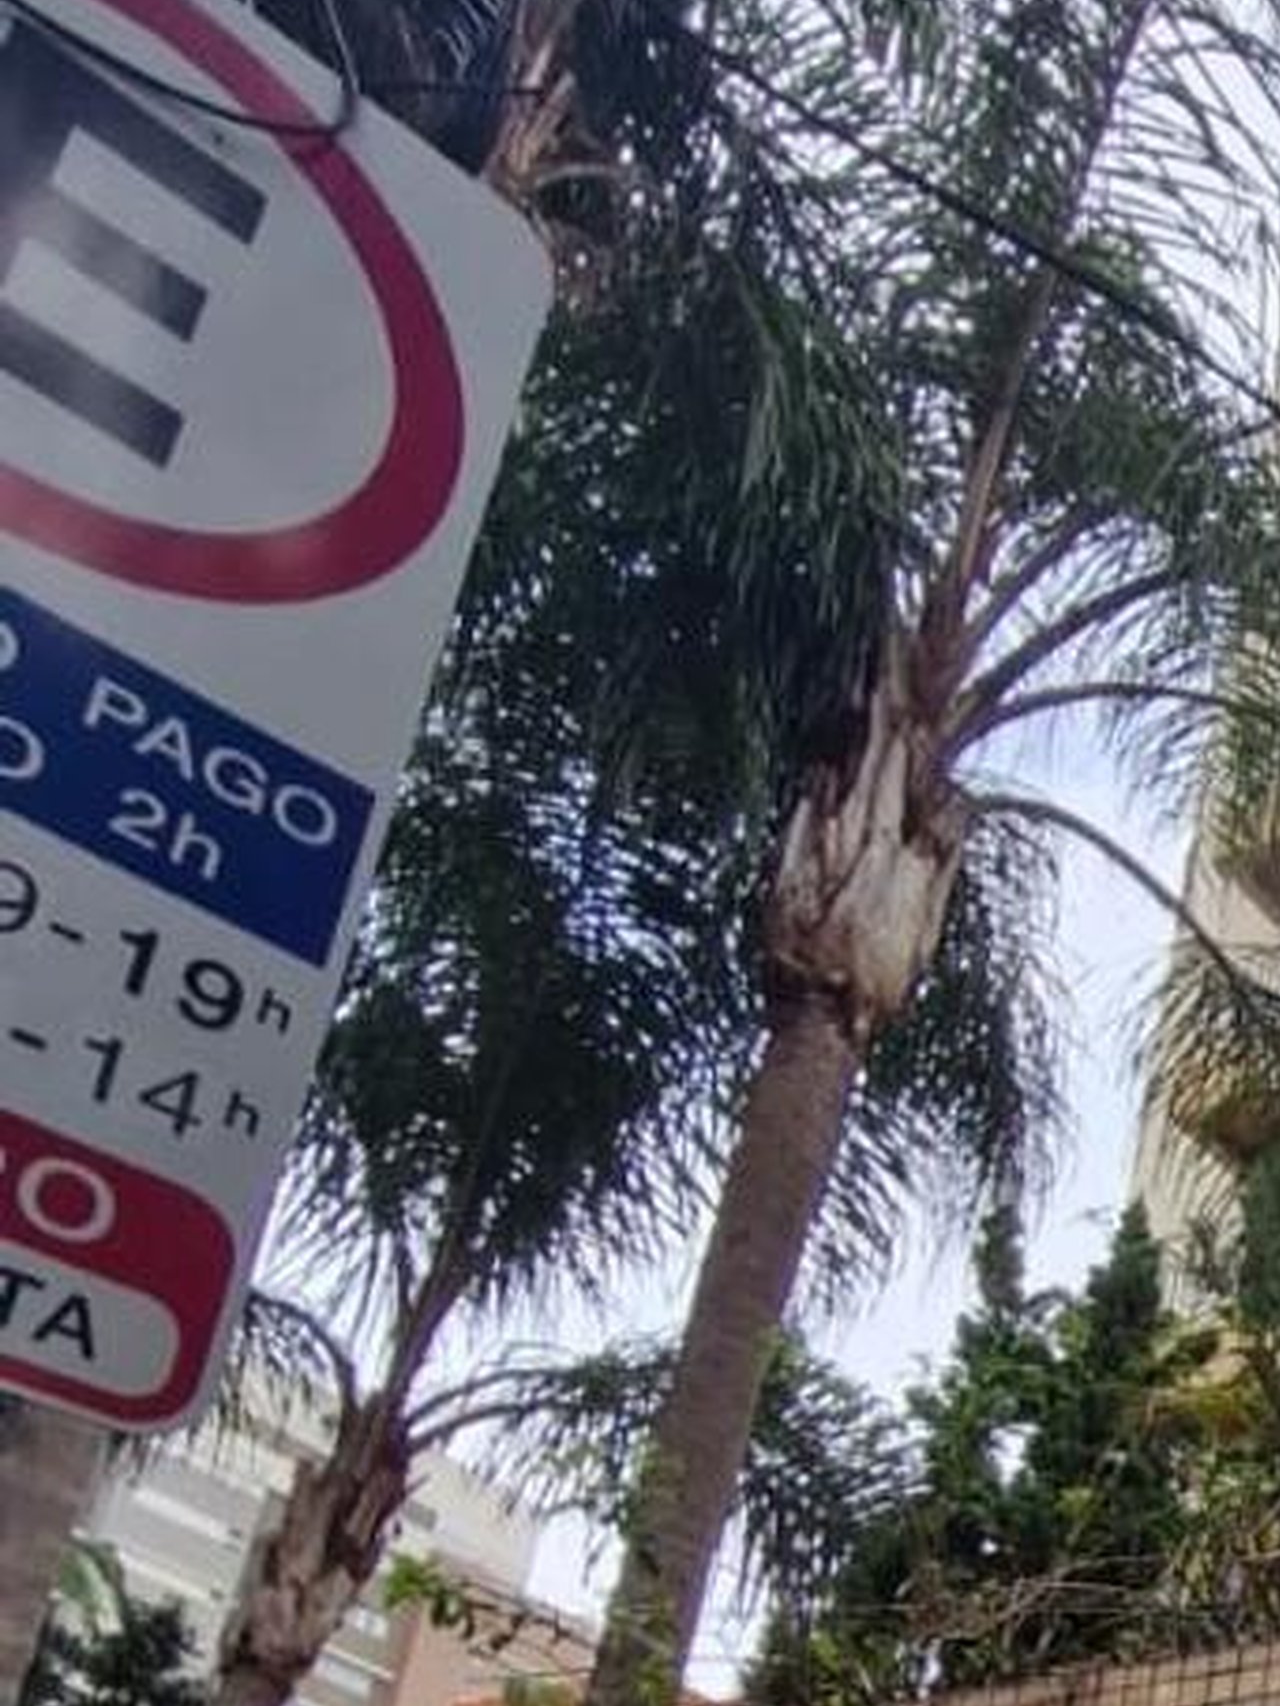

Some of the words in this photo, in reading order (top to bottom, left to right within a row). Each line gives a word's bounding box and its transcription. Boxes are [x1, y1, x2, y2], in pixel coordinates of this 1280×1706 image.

[0, 9, 269, 471] E
[82, 675, 337, 847] PAGO
[108, 789, 223, 881] 2h
